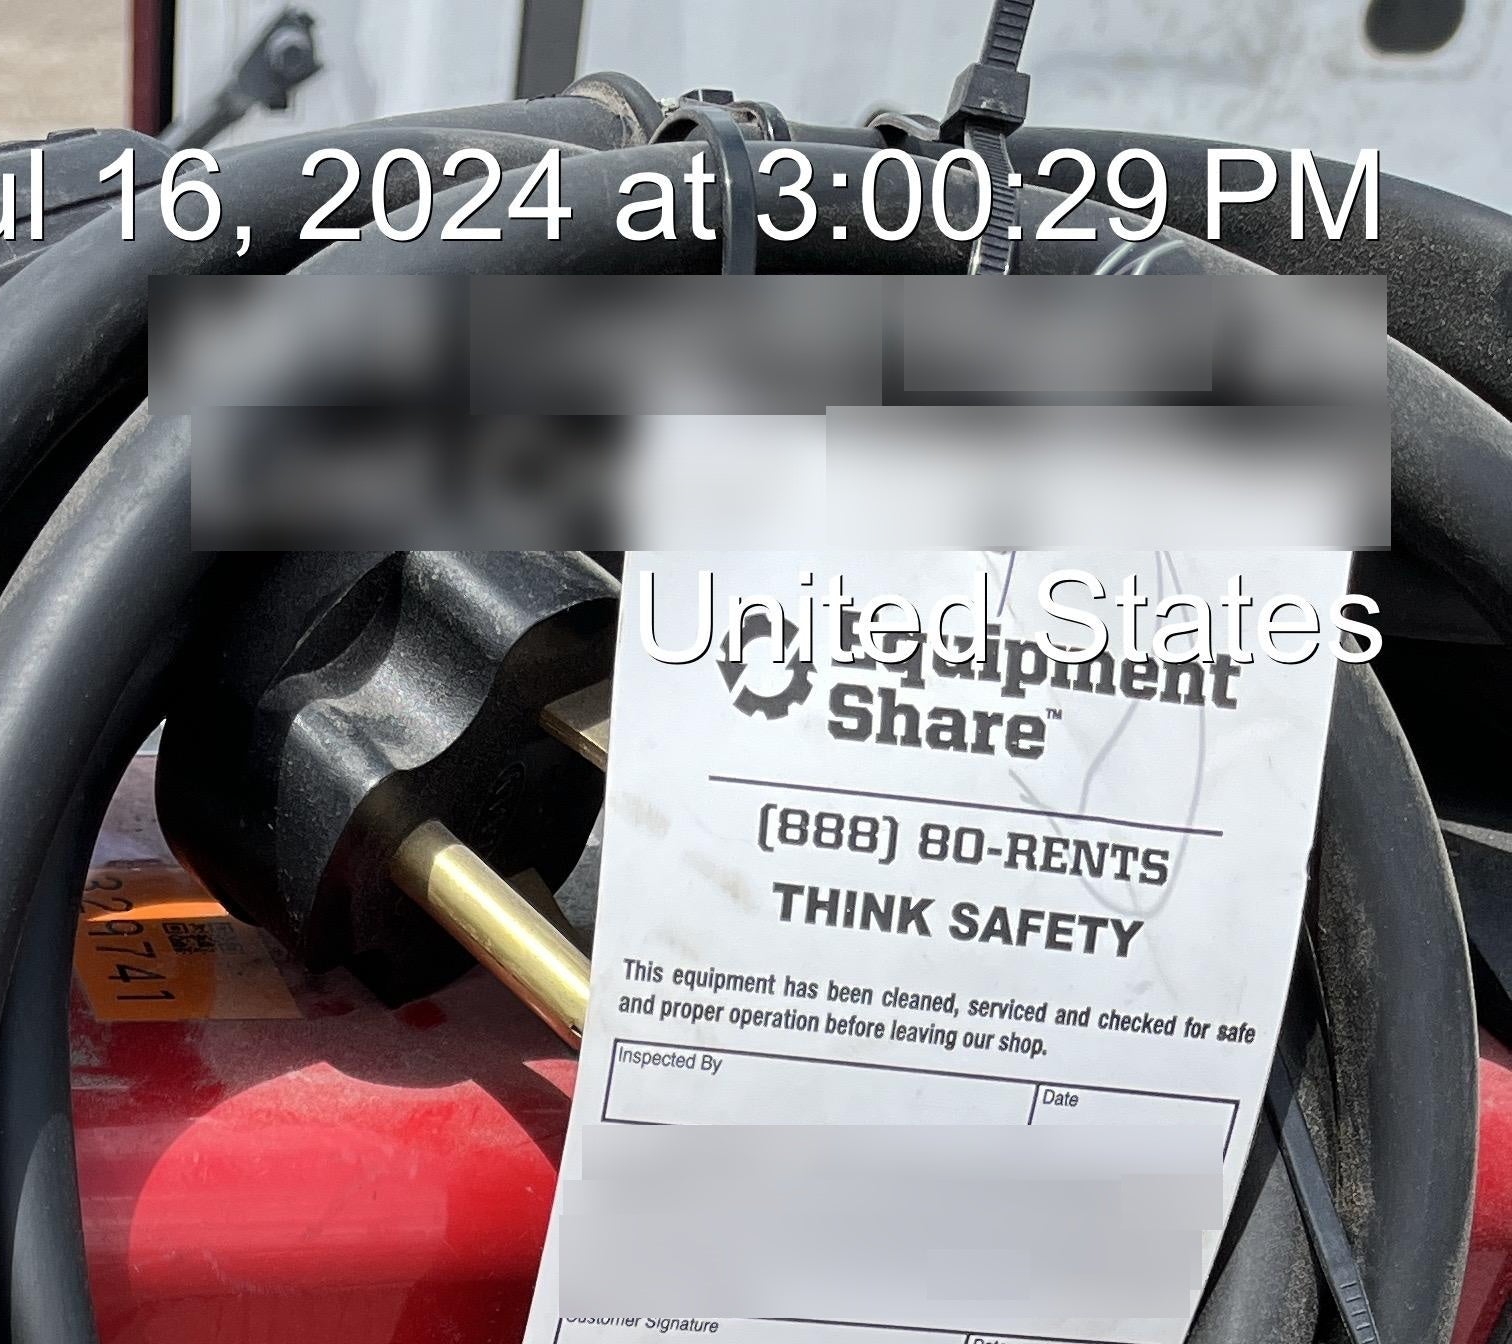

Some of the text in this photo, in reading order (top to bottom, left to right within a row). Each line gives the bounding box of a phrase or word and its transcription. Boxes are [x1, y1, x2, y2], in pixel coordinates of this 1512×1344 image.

[757, 802, 1171, 887] (888) 80-RENTS
[772, 881, 1144, 959] THINK SAFETY
[618, 993, 1049, 1060] and proper operation before leaving our shop.
[623, 958, 1257, 1045] This equipment has been cleaned, serviced and checked for safe
[617, 1045, 724, 1077] Inspected By
[1041, 1087, 1080, 1108] Date
